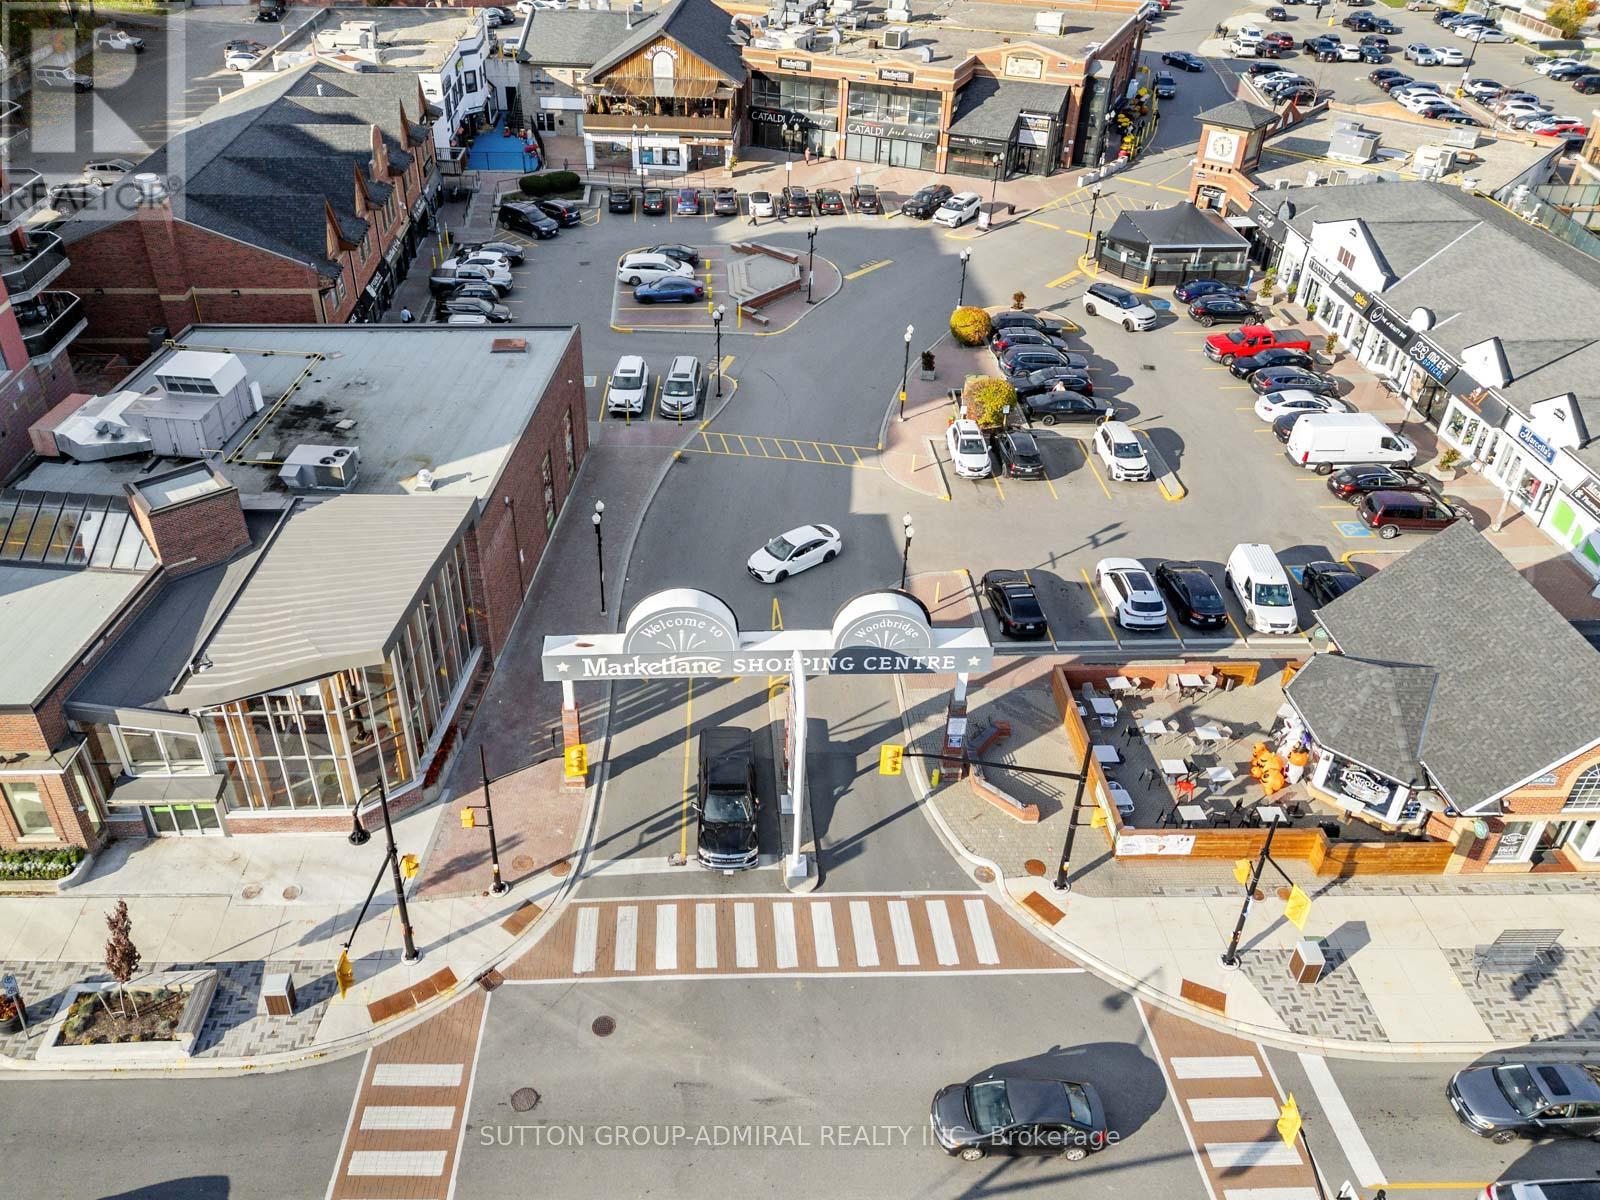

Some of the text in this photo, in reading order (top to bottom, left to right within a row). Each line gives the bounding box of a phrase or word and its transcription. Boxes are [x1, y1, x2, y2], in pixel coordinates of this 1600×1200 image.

[751, 111, 786, 123] CATALDI
[847, 123, 884, 136] CATALDI
[1422, 357, 1444, 380] OPTICAL
[1436, 358, 1452, 374] EYE
[1520, 428, 1552, 458] Marcella's
[640, 617, 723, 639] Welcome to
[854, 618, 920, 639] Woodbridge
[582, 655, 725, 678] Marketlane
[863, 655, 956, 671] CENTRE
